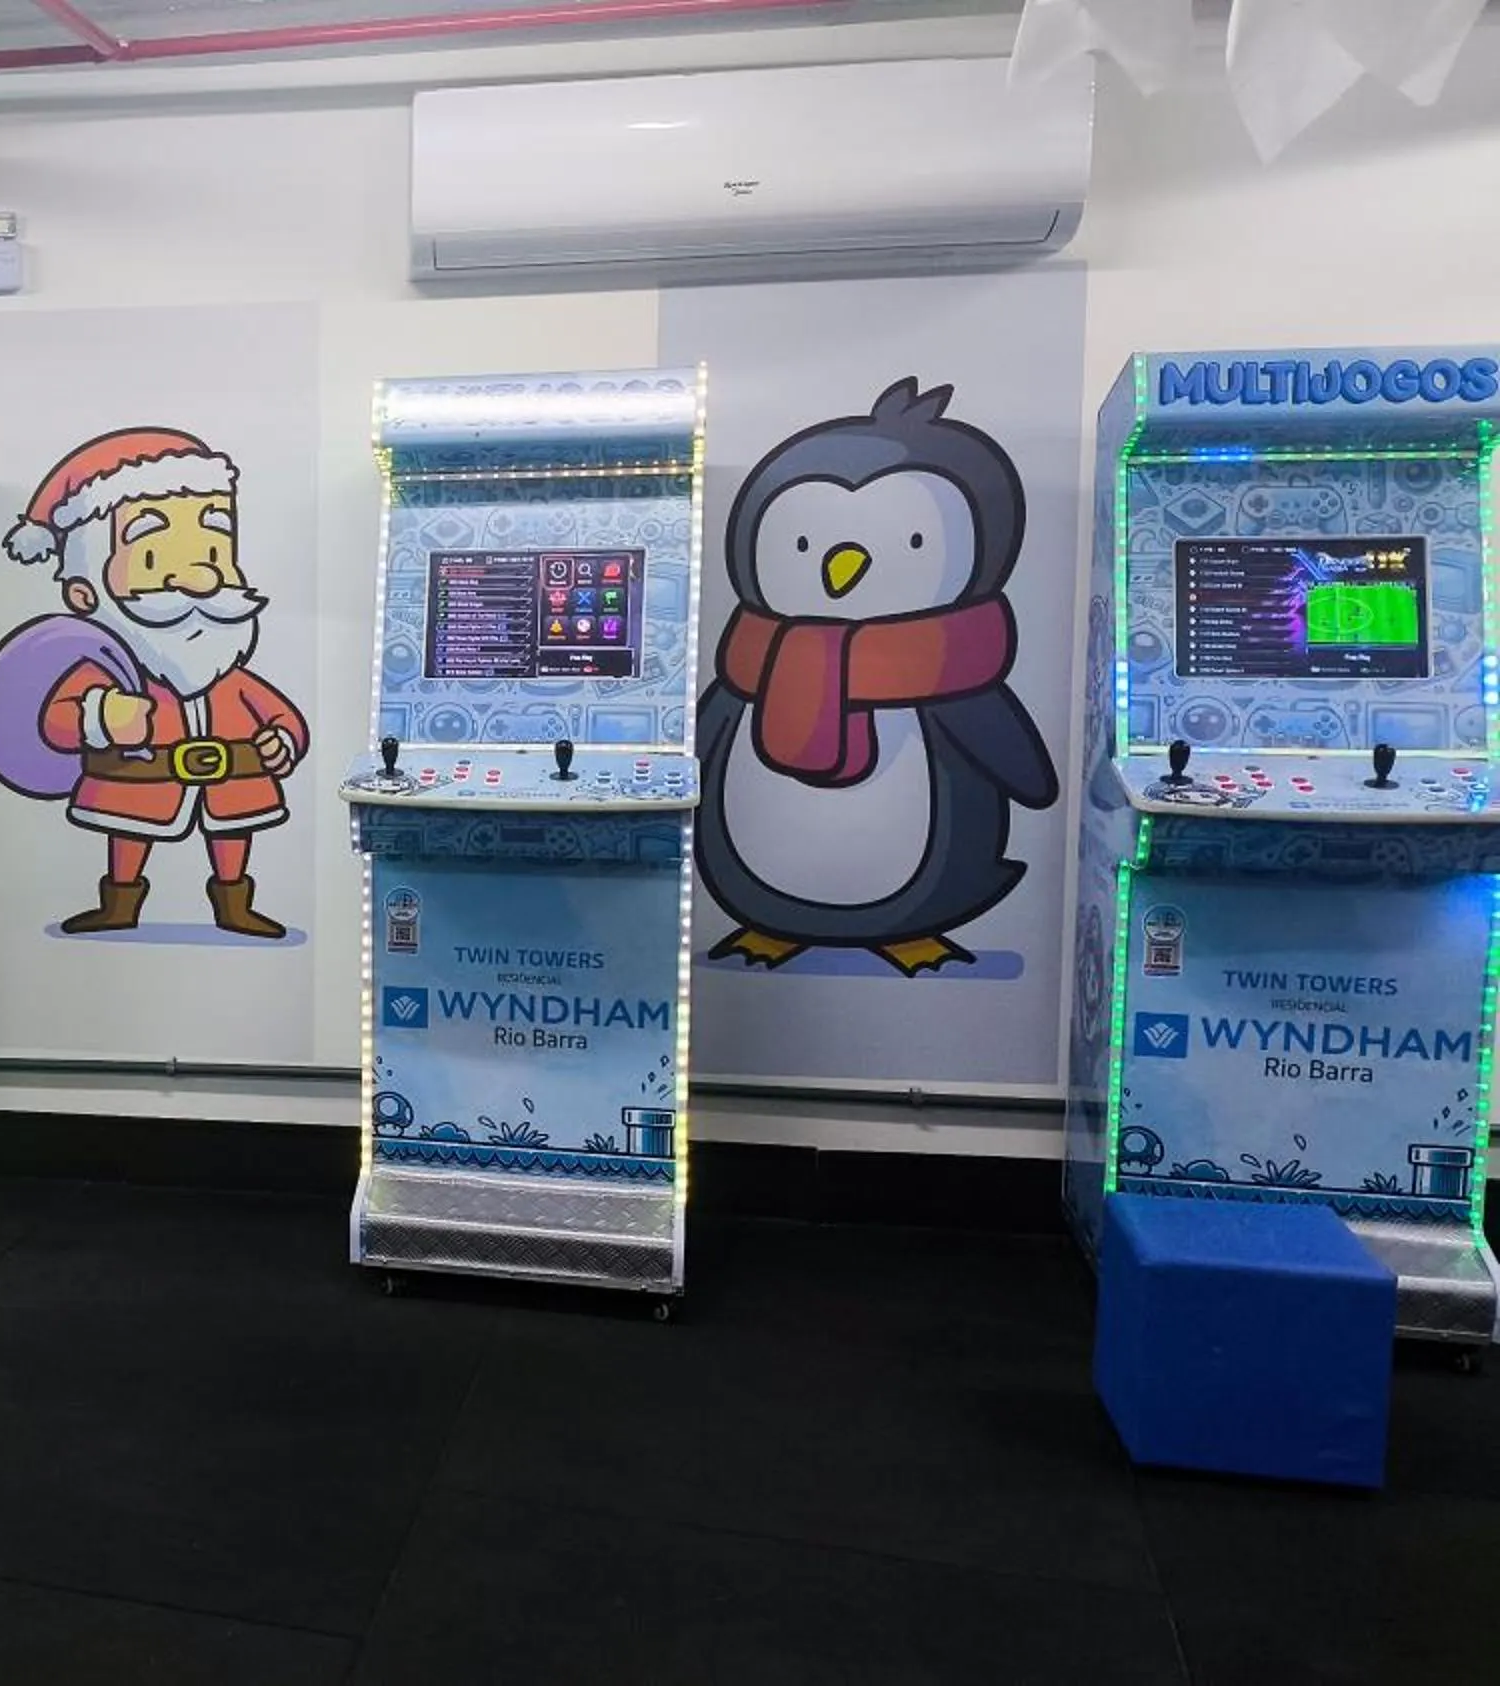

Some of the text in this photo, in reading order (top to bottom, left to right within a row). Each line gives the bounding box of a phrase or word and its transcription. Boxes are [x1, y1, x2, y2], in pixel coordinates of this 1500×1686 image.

[1159, 357, 1499, 405] MULTIJOGOS
[453, 946, 605, 969] TWIN TOWERS
[1222, 969, 1398, 997] TWIN TOWERS
[437, 989, 670, 1031] WYNDHAM
[494, 1025, 588, 1050] Rio Barra
[1201, 1016, 1473, 1063] WYNDHAM
[1264, 1056, 1374, 1084] Rio Barra
